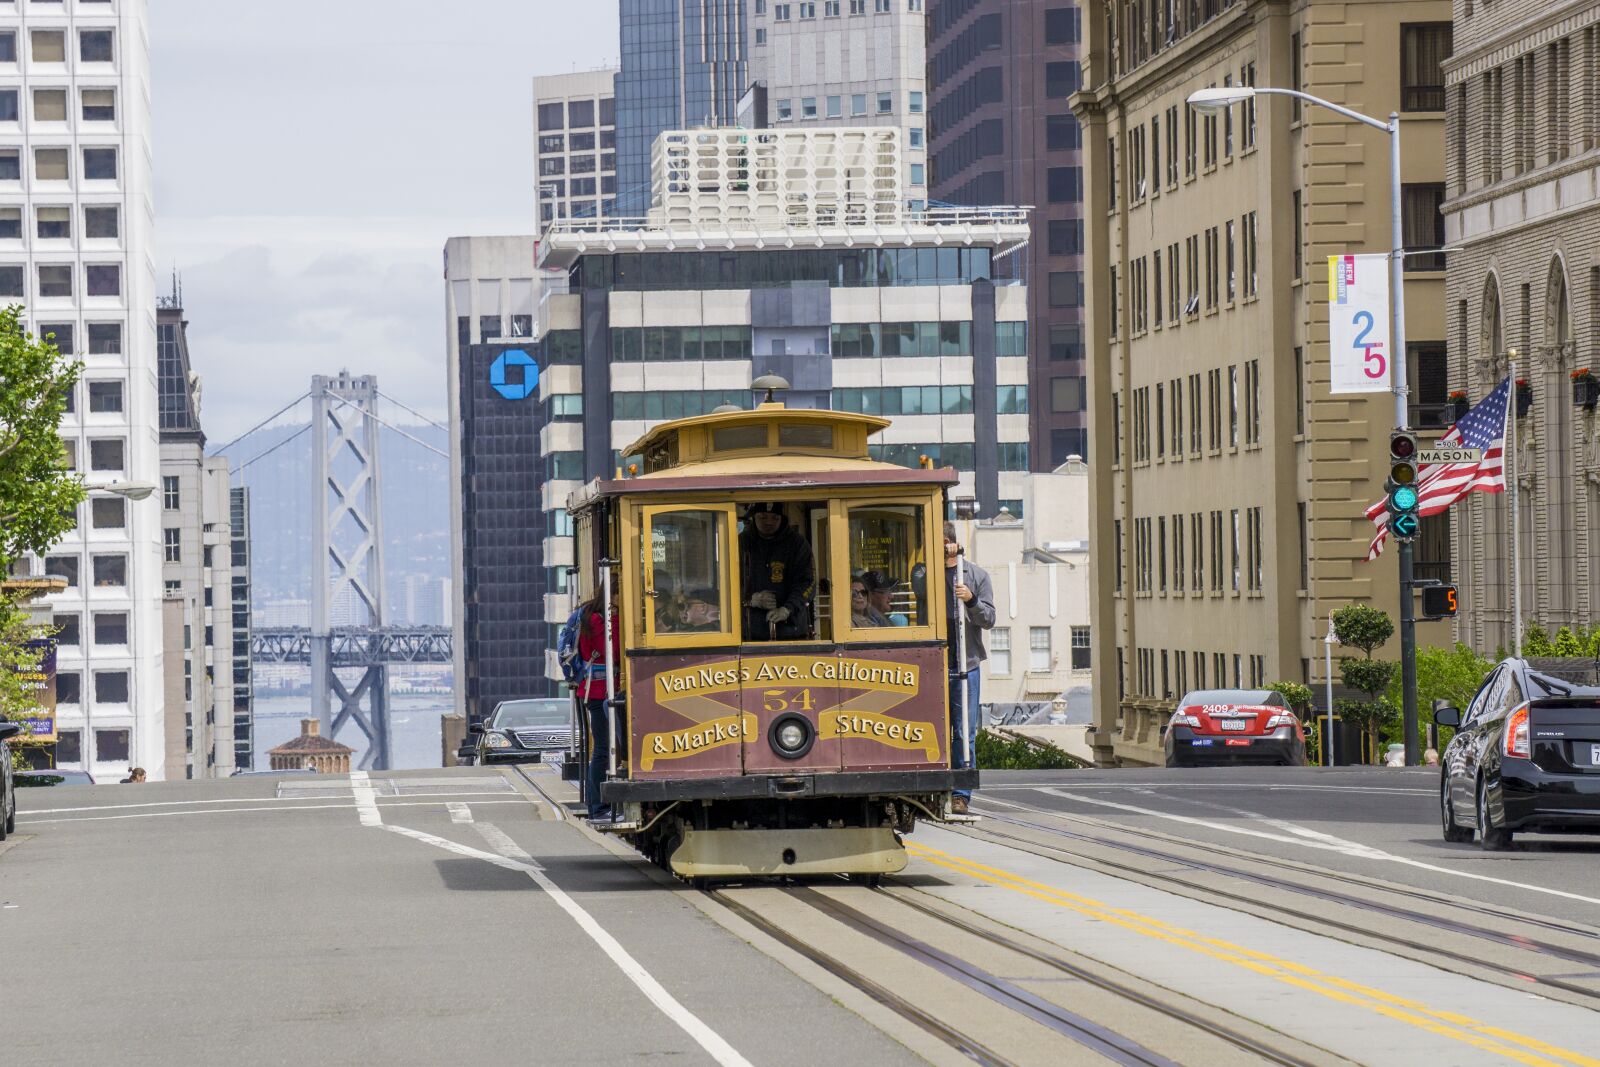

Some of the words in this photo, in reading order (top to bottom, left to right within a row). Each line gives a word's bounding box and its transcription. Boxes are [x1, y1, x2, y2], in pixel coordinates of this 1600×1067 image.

[1338, 264, 1346, 298] CENTURY
[1421, 451, 1472, 461] MASON
[1447, 590, 1457, 611] 5
[660, 675, 696, 694] Van
[698, 667, 750, 689] Ness
[811, 661, 915, 687] California
[763, 688, 816, 712] 54
[1202, 704, 1229, 714] 2409
[652, 736, 668, 754] &
[672, 715, 748, 752] Market
[836, 714, 924, 743] Streets
